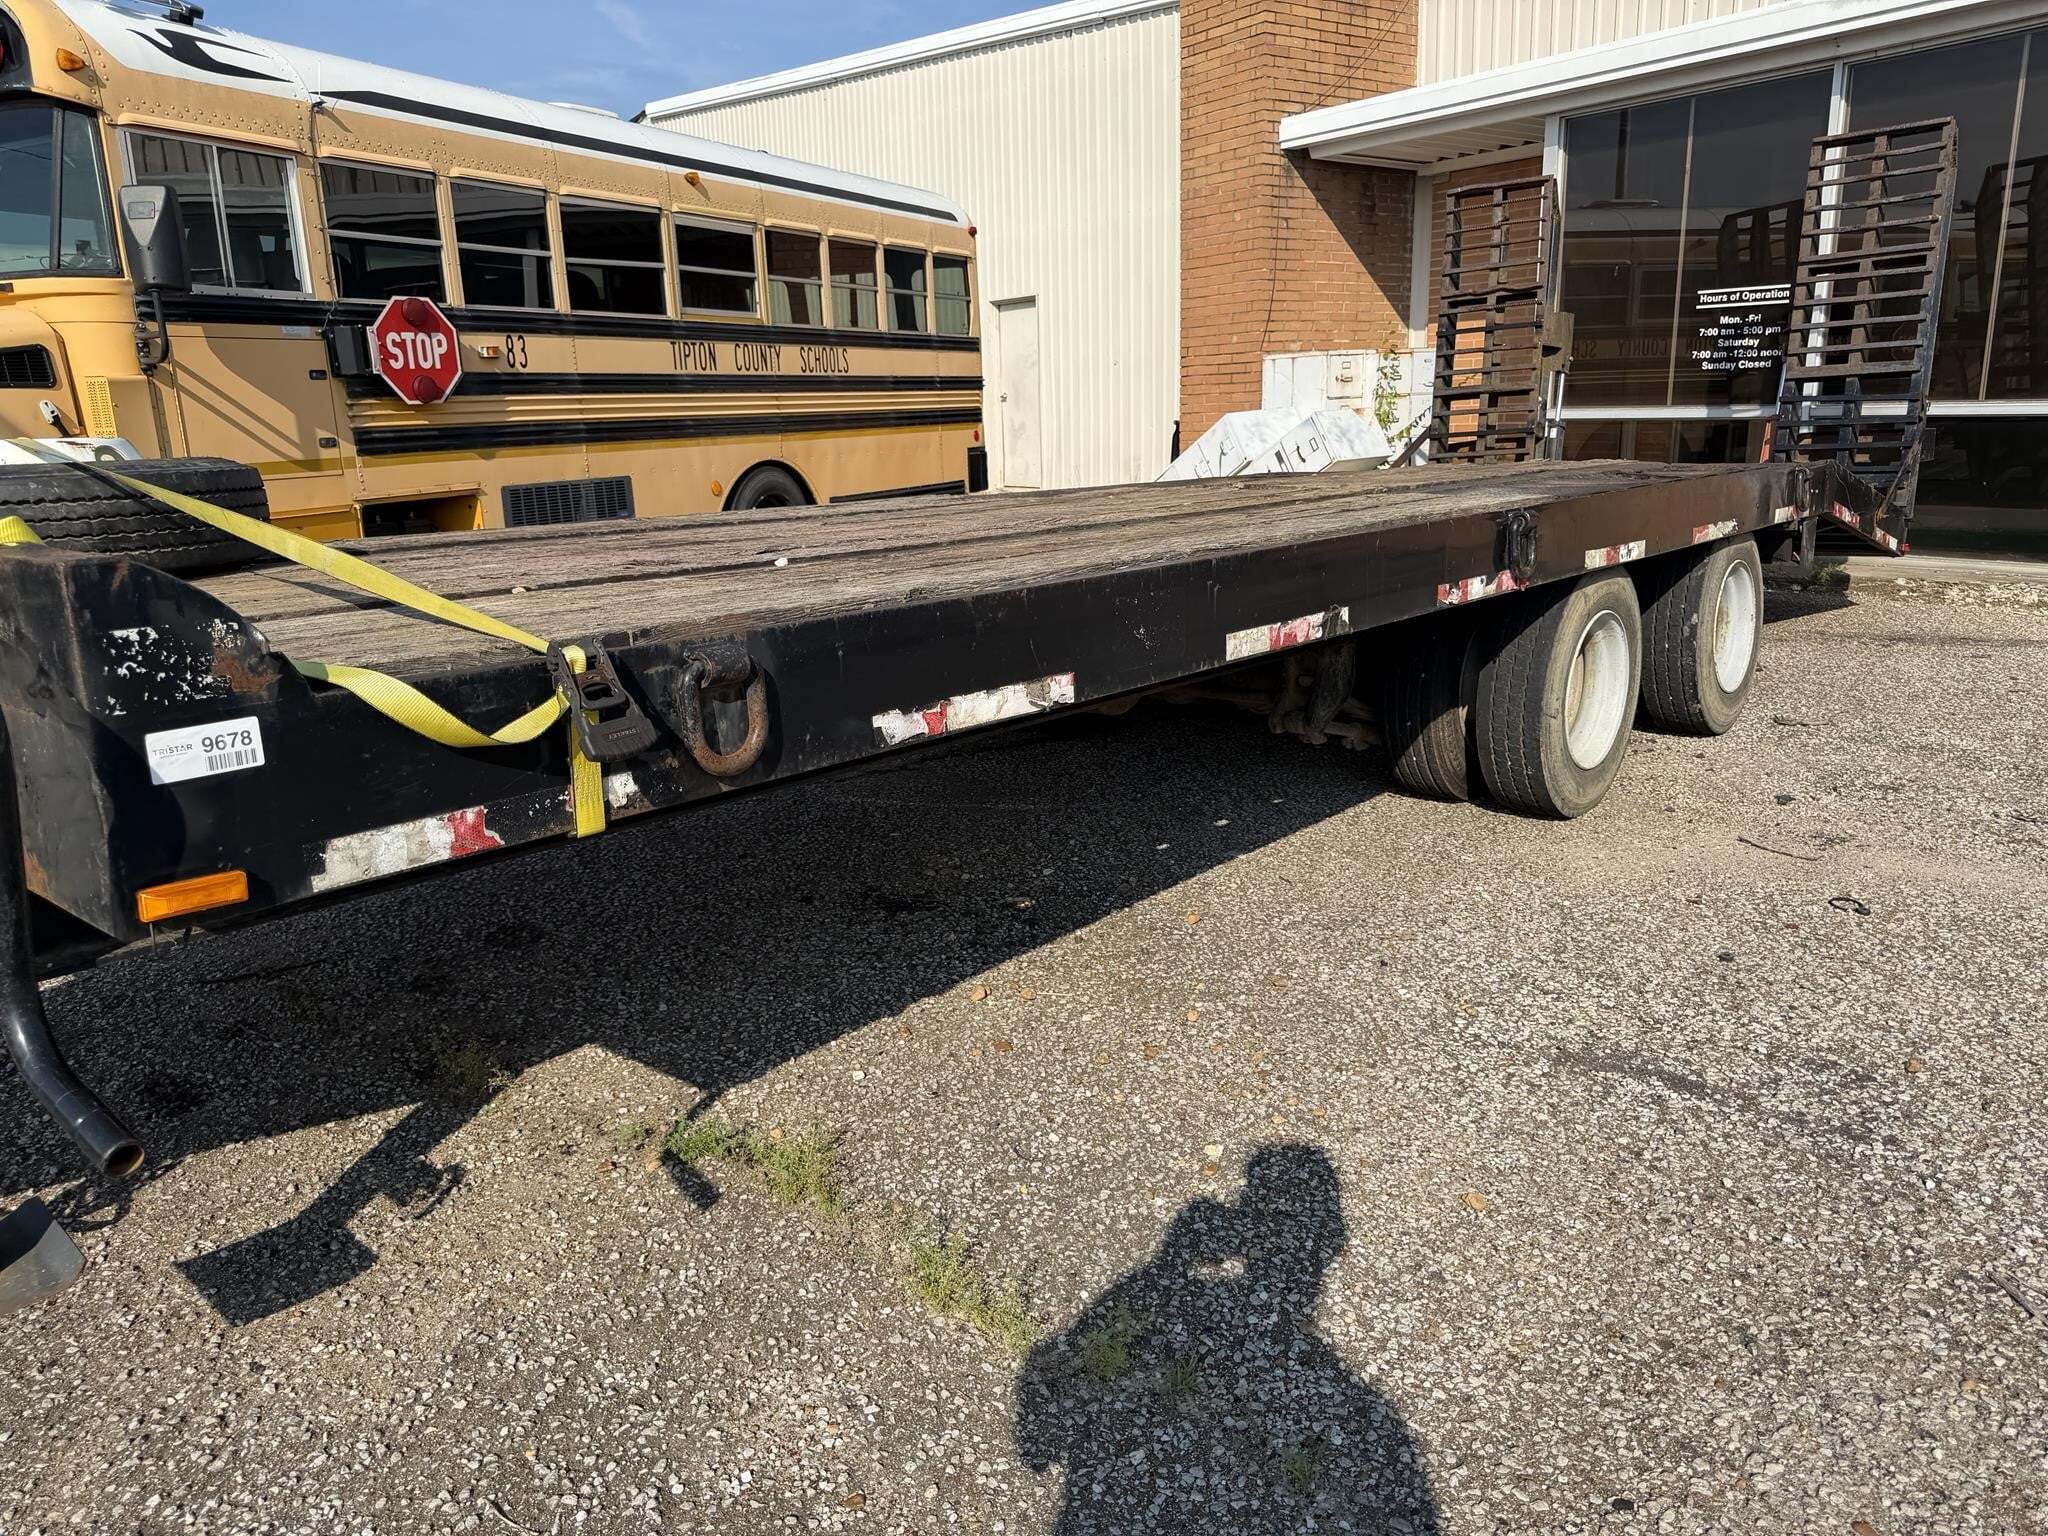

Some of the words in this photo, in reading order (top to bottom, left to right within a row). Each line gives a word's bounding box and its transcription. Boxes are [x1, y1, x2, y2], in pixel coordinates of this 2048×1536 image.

[1700, 294, 1728, 303] Hours
[1730, 292, 1740, 301] of
[1742, 289, 1790, 300] Operation
[1720, 315, 1742, 324] Mon.
[1699, 328, 1718, 337] 7:00
[1743, 326, 1763, 334] 5:00
[1765, 326, 1781, 336] pm
[1717, 338, 1760, 348] Saturday
[385, 332, 448, 370] STOP
[505, 334, 528, 369] 83
[670, 341, 718, 371] TIPTON
[734, 343, 782, 372] COUNTY
[800, 347, 849, 373] SCHOOLS
[1691, 351, 1711, 359] 7:00
[1701, 361, 1736, 371] Sunday
[1738, 360, 1772, 369] Closed
[201, 730, 253, 753] 9678
